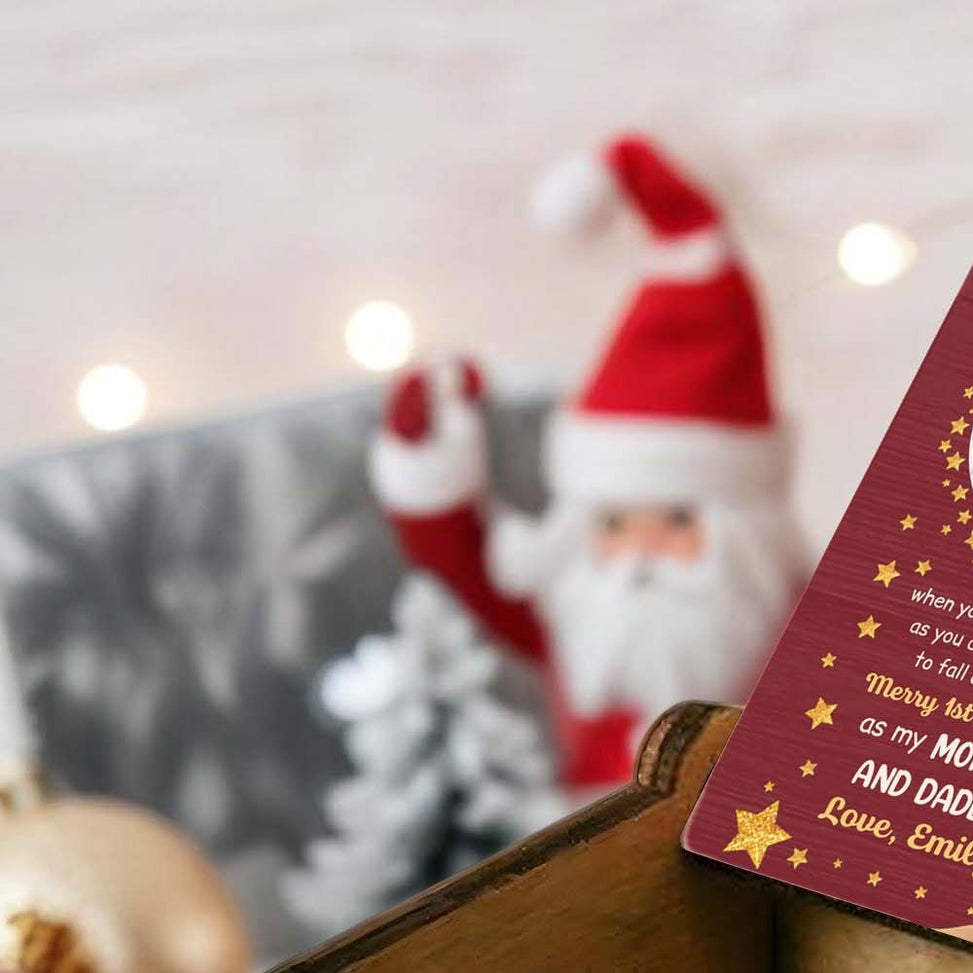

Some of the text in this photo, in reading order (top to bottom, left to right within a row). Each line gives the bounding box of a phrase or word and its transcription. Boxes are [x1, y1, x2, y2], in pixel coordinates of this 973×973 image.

[911, 588, 955, 612] when
[909, 621, 929, 636] as
[934, 629, 961, 648] you
[915, 651, 933, 670] to
[938, 658, 968, 681] fall
[865, 672, 939, 717] Merry
[946, 697, 973, 722] 1st
[859, 716, 884, 737] as
[890, 727, 928, 754] my
[851, 759, 912, 797] AND
[818, 796, 896, 846] Love,
